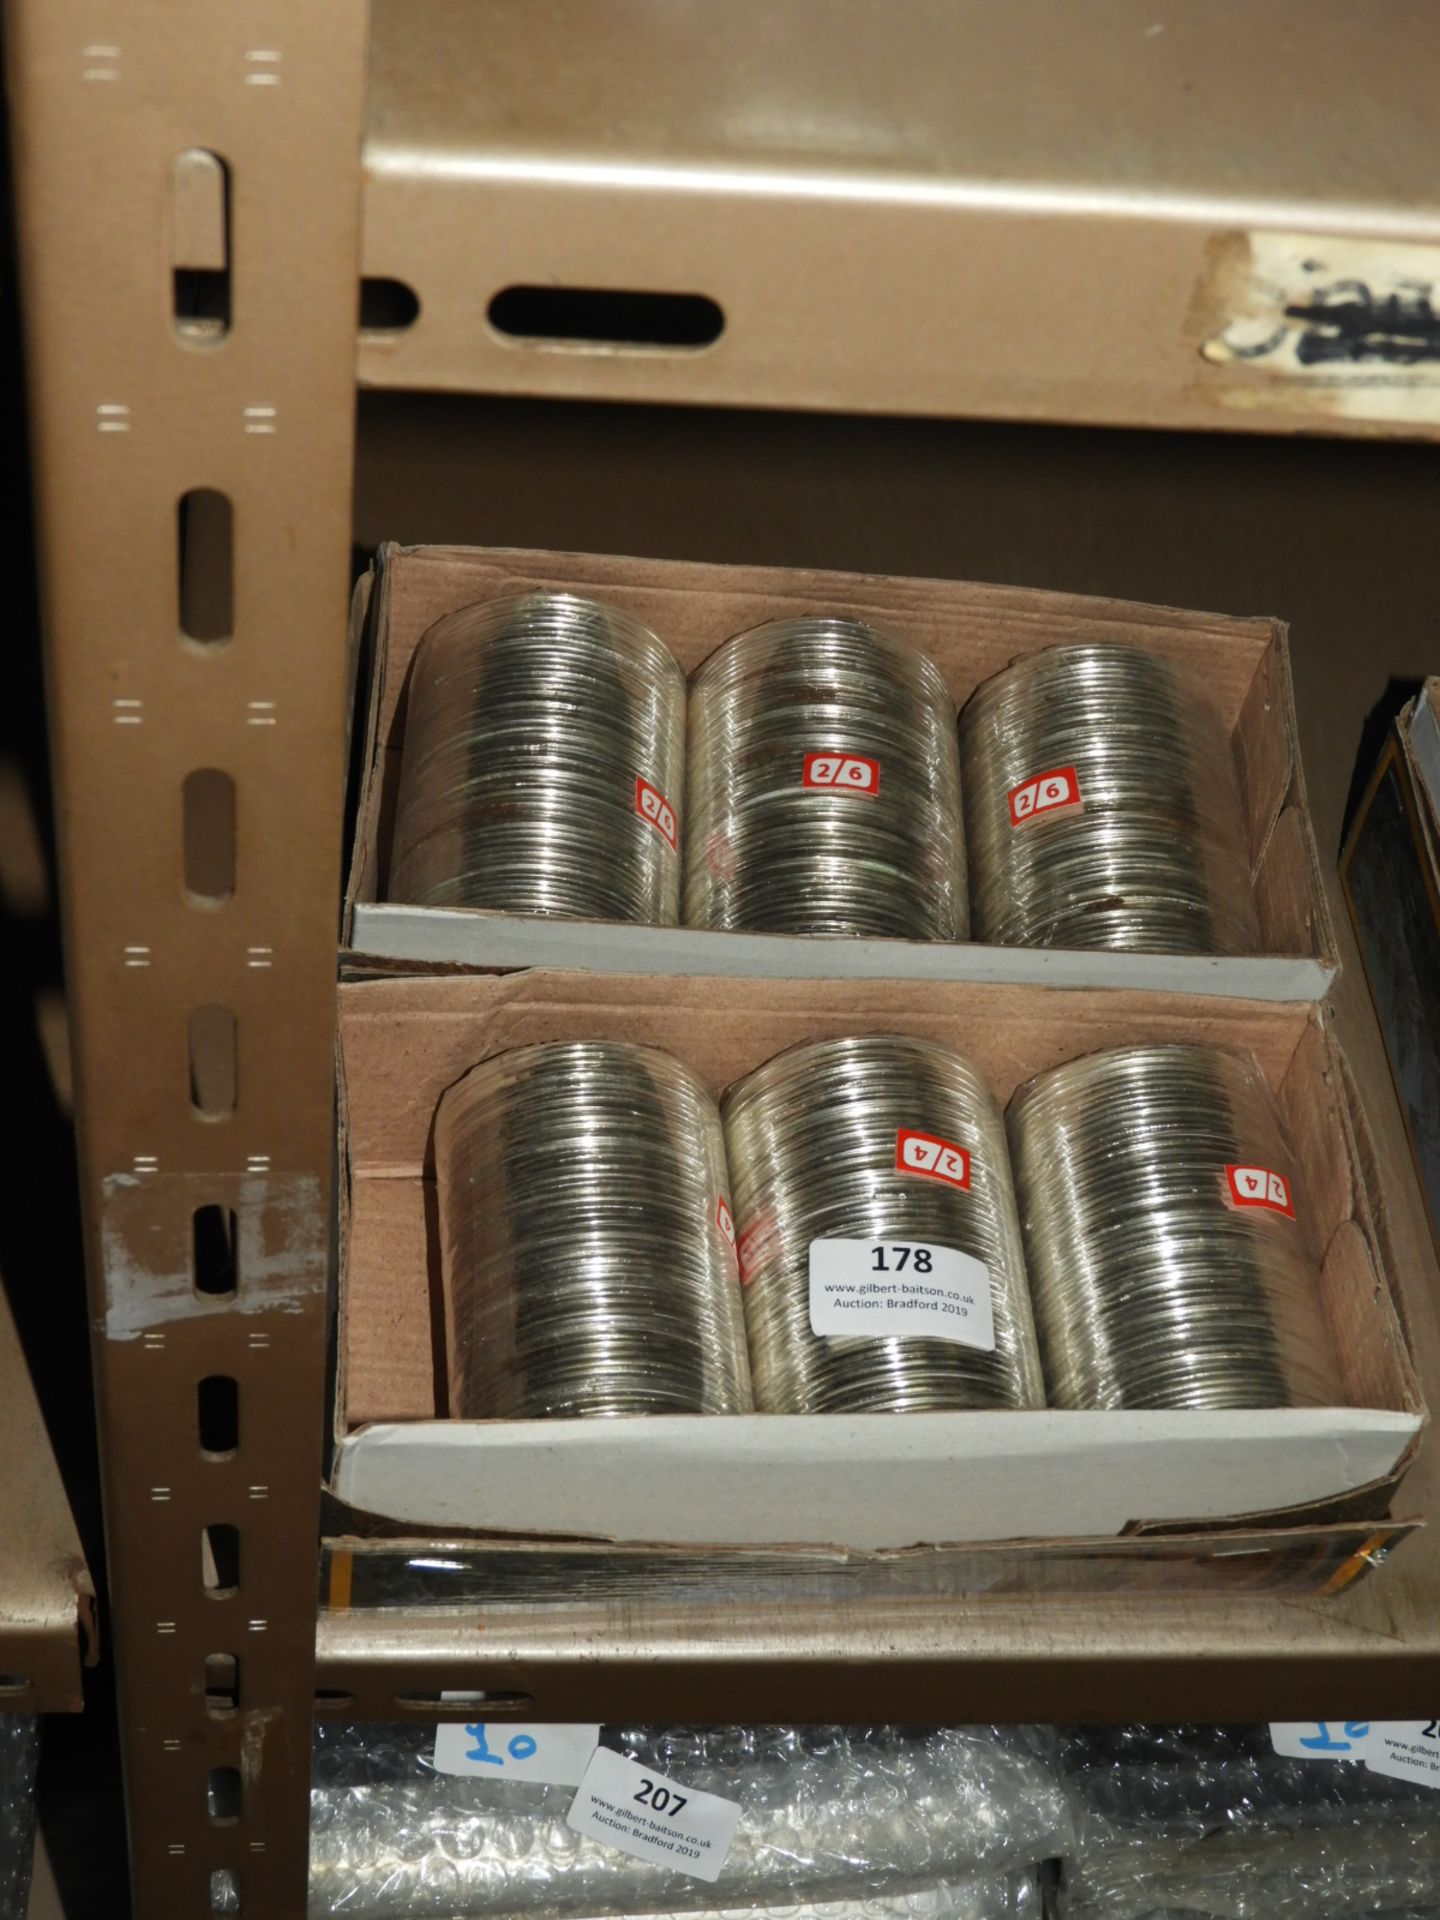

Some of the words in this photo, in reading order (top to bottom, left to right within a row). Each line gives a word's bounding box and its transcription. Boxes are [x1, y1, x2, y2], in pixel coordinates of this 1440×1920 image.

[871, 1246, 933, 1273] 178
[824, 1283, 975, 1305] www.gilbert-baitson.co.uk
[833, 1298, 883, 1309] Auction:
[887, 1298, 938, 1311] Bradford
[941, 1302, 968, 1317] 2019
[1389, 1752, 1428, 1769] Auction:
[633, 1779, 688, 1817] 207
[590, 1795, 712, 1849] www.gilbert-baitson.co.uk
[591, 1811, 631, 1834] Auction:
[632, 1828, 675, 1850] Bradford
[676, 1844, 701, 1859] 2019
